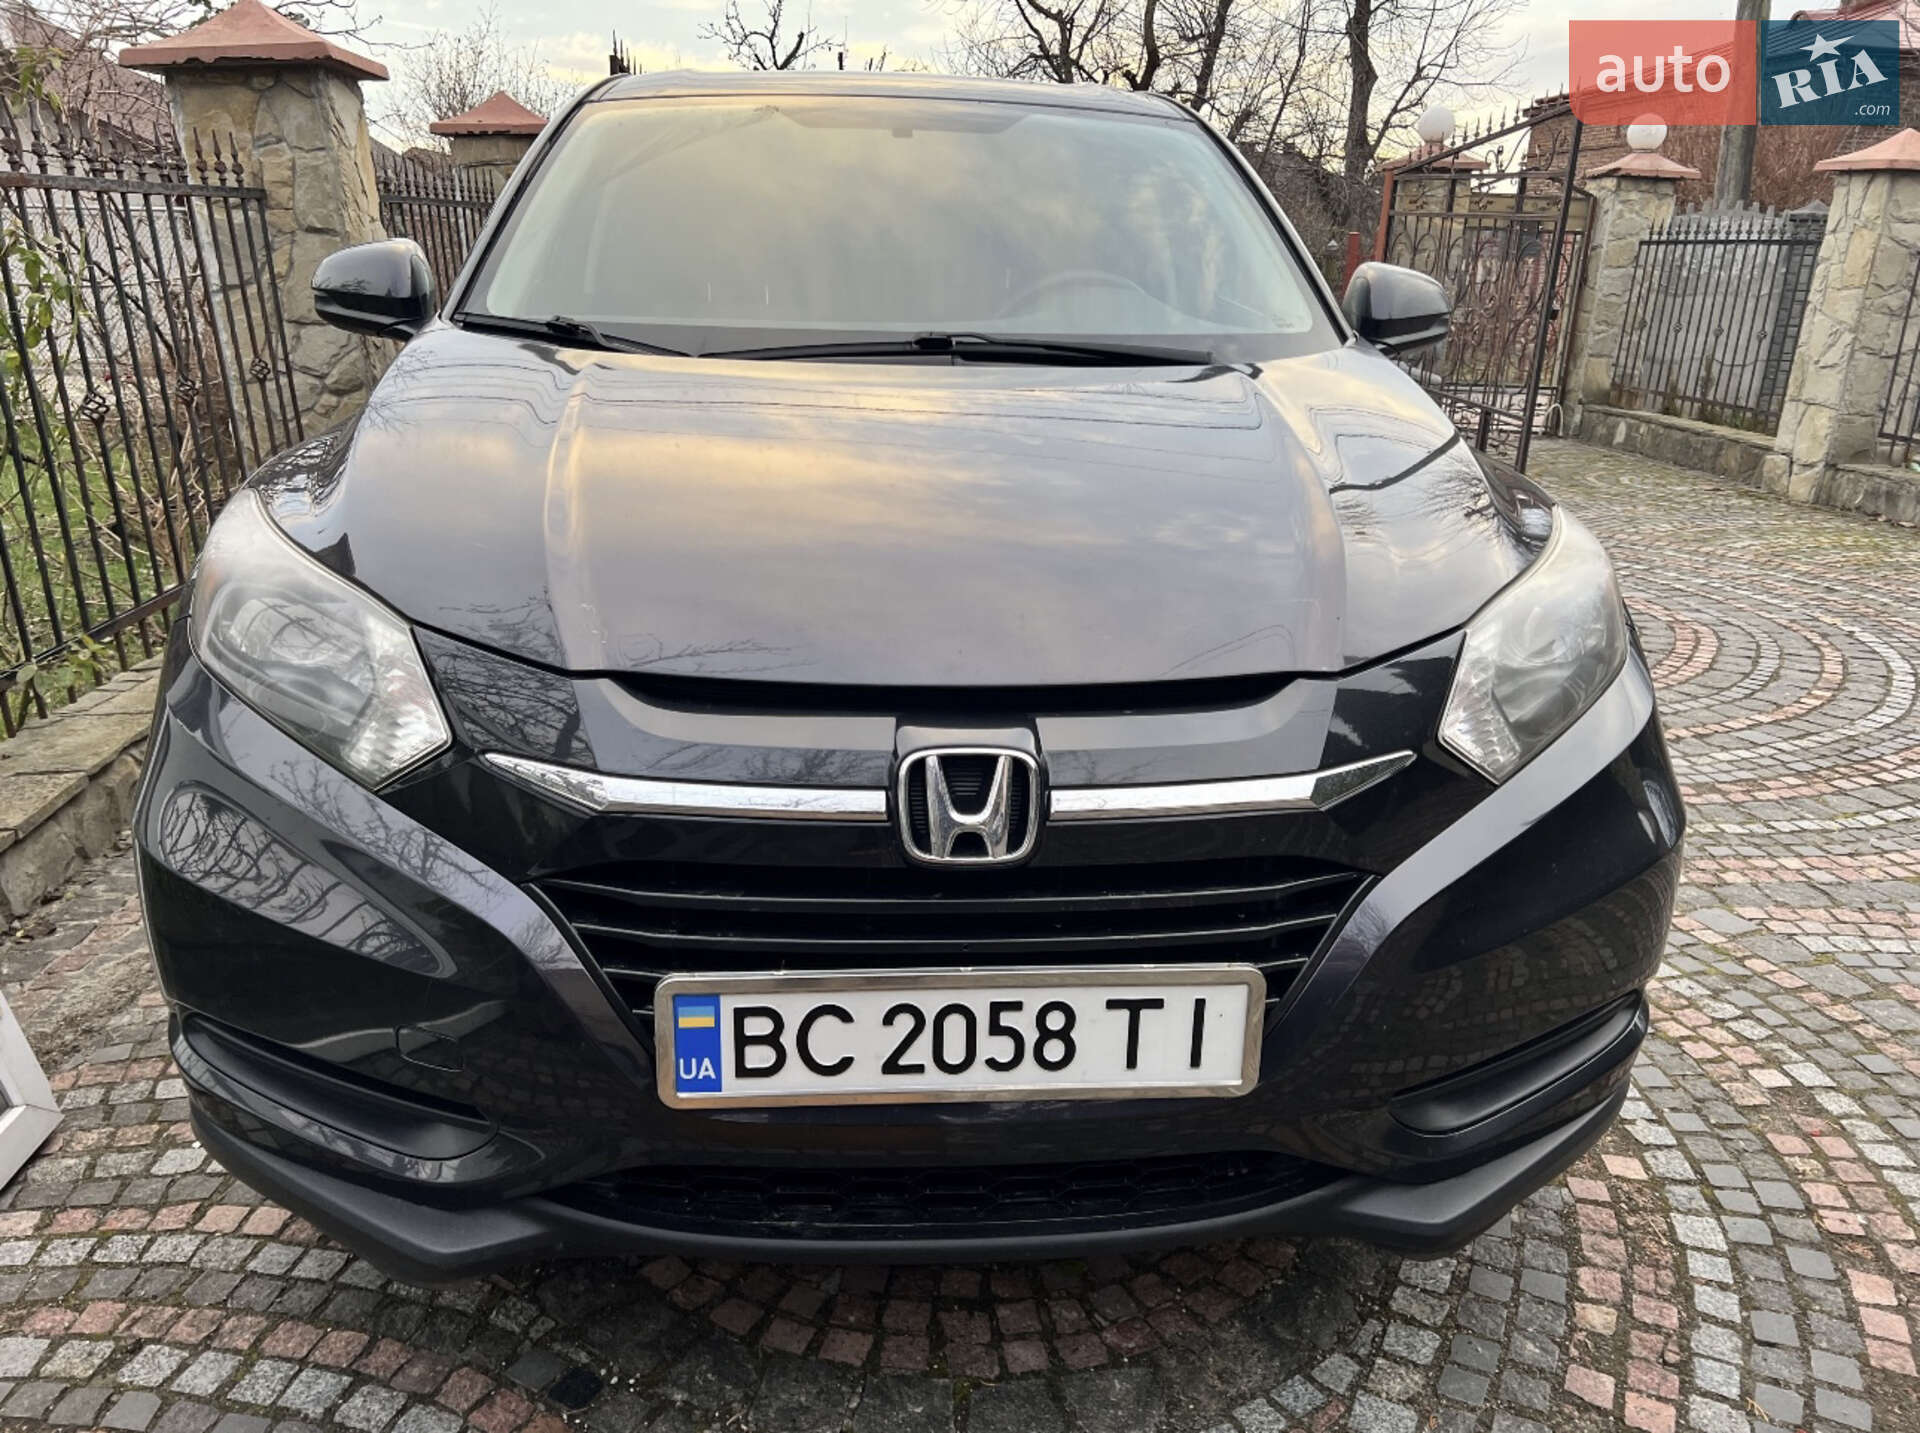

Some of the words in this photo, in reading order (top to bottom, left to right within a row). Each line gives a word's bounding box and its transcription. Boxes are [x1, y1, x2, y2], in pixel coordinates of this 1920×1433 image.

[733, 1003, 855, 1079] BC
[881, 1000, 1077, 1076] 2058
[679, 1057, 717, 1080] UA
